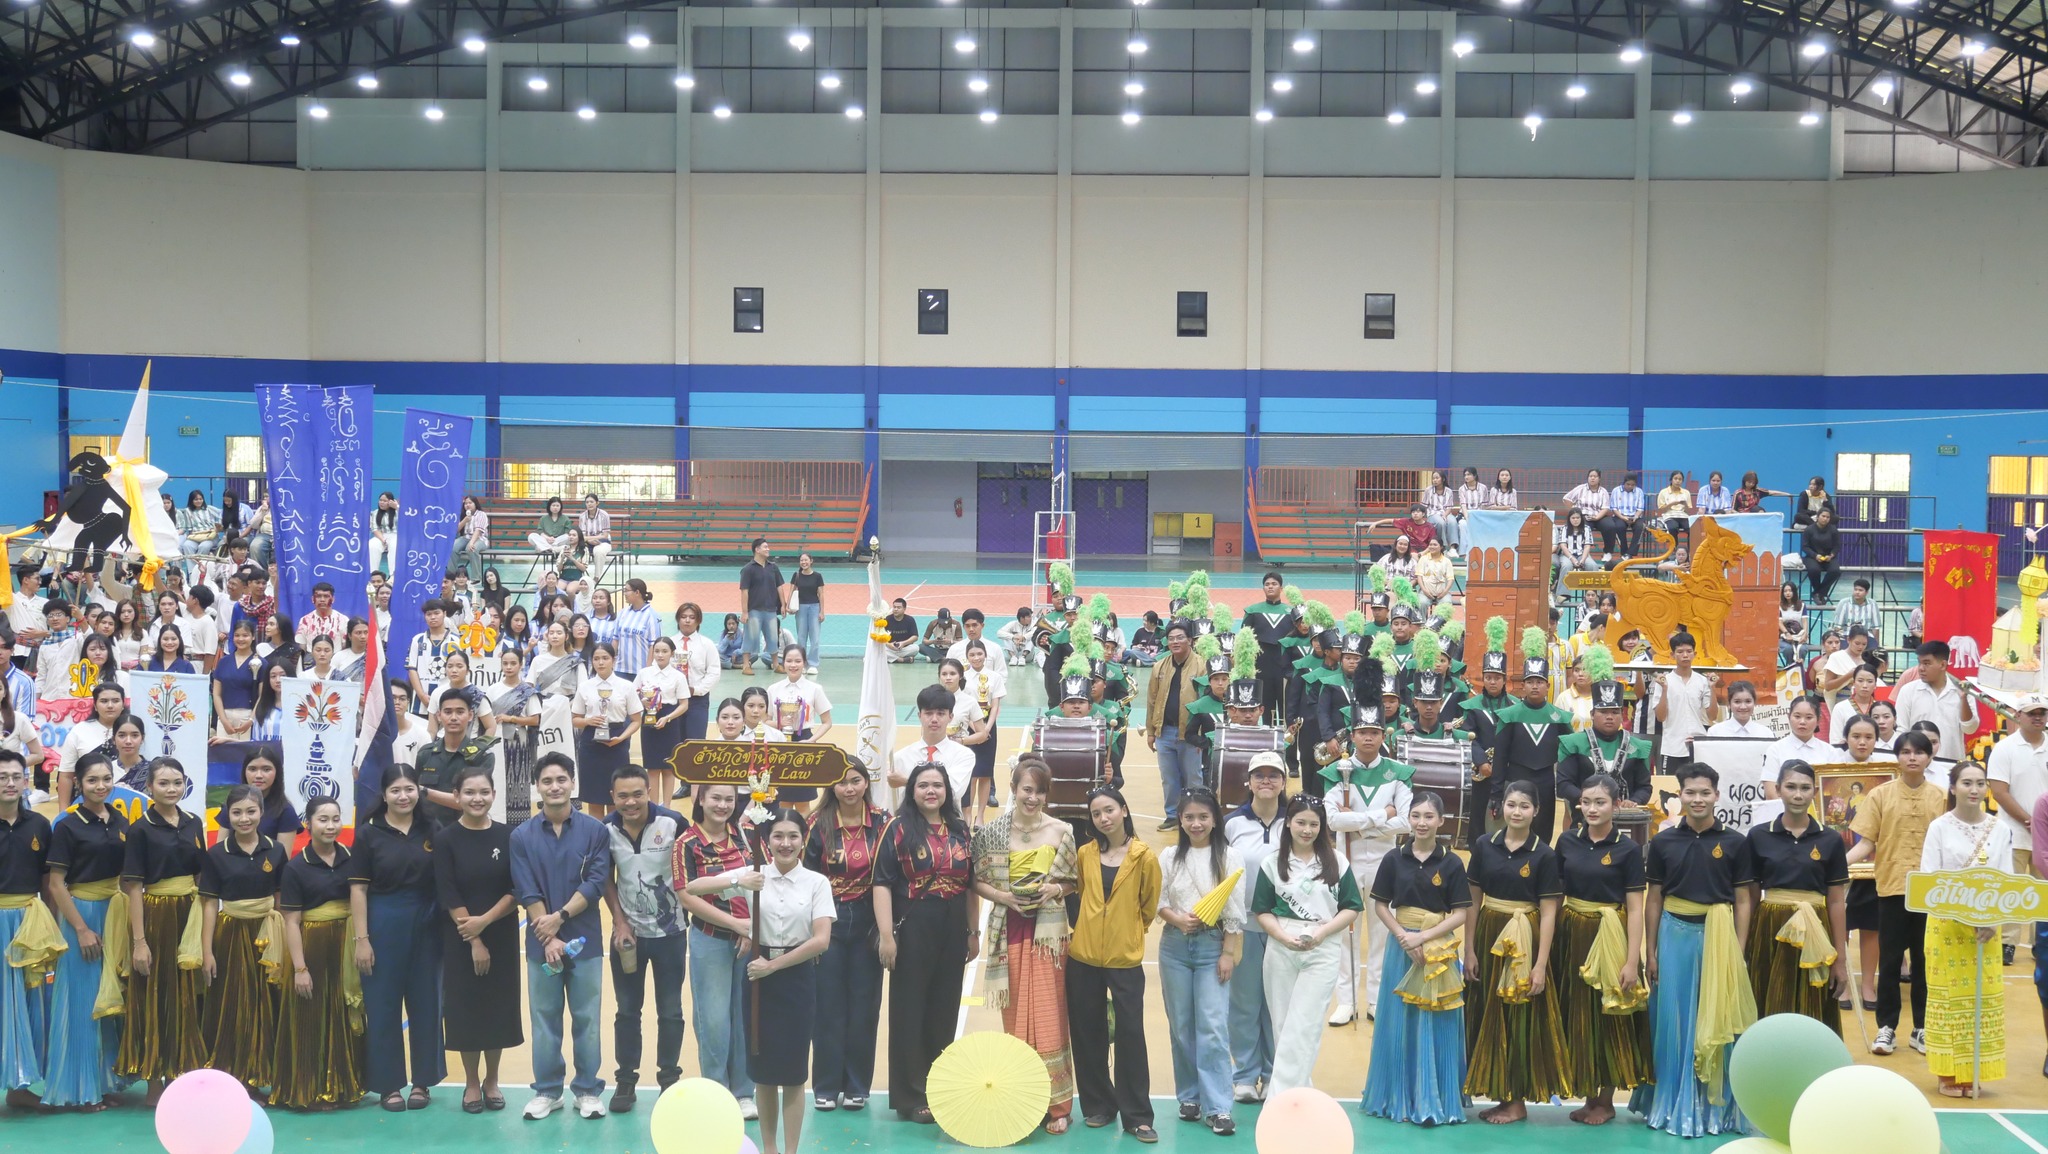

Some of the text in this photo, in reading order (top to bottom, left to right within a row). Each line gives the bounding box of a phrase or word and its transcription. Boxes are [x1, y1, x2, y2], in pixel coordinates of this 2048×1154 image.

[1195, 517, 1201, 528] 1
[1225, 543, 1232, 554] 3
[693, 745, 826, 767] สำนักวิชานิติศาสตร์
[779, 767, 811, 780] Law
[1924, 878, 2040, 914] สีเหลือง
[1281, 891, 1313, 921] LAW WU
